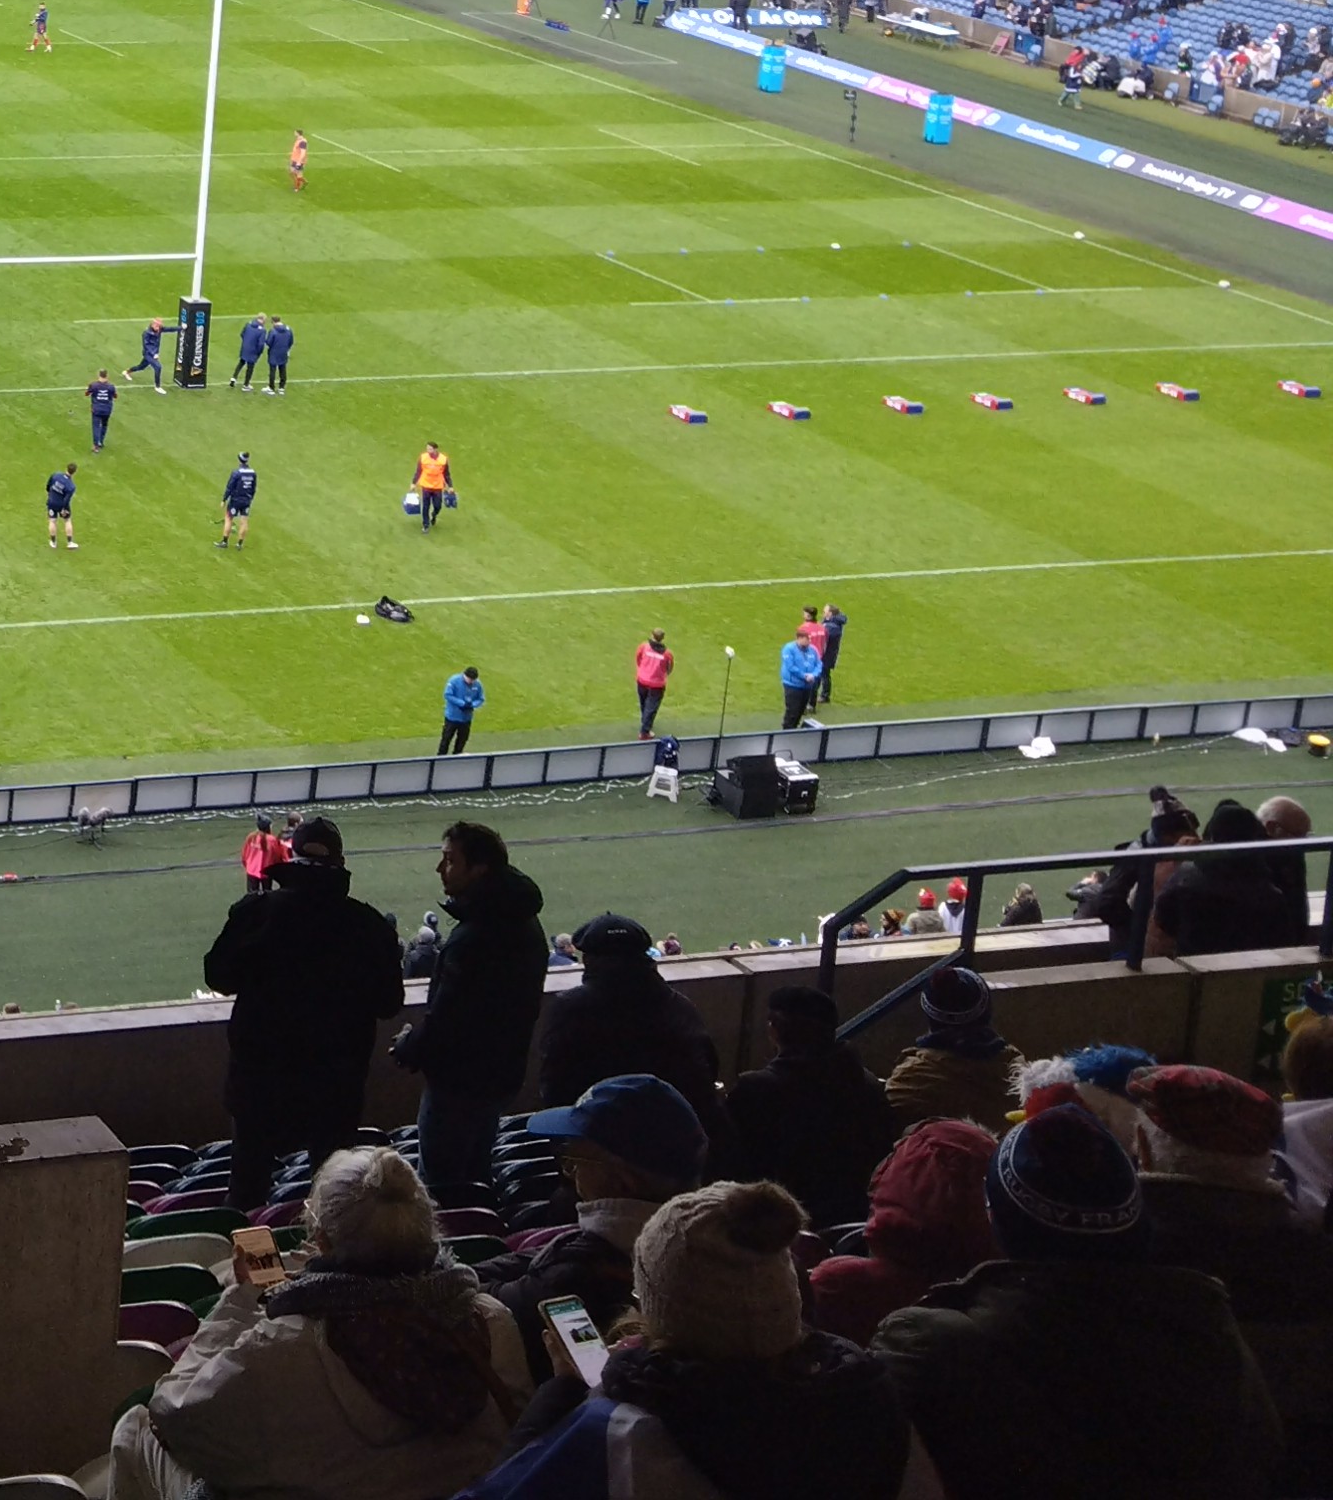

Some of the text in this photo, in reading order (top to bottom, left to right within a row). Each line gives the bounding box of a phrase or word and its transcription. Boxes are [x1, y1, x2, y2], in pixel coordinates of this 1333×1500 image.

[759, 10, 783, 26] As
[783, 10, 823, 26] One
[1141, 163, 1236, 199] Scottish Rugby TV
[193, 325, 205, 366] GUINNESS
